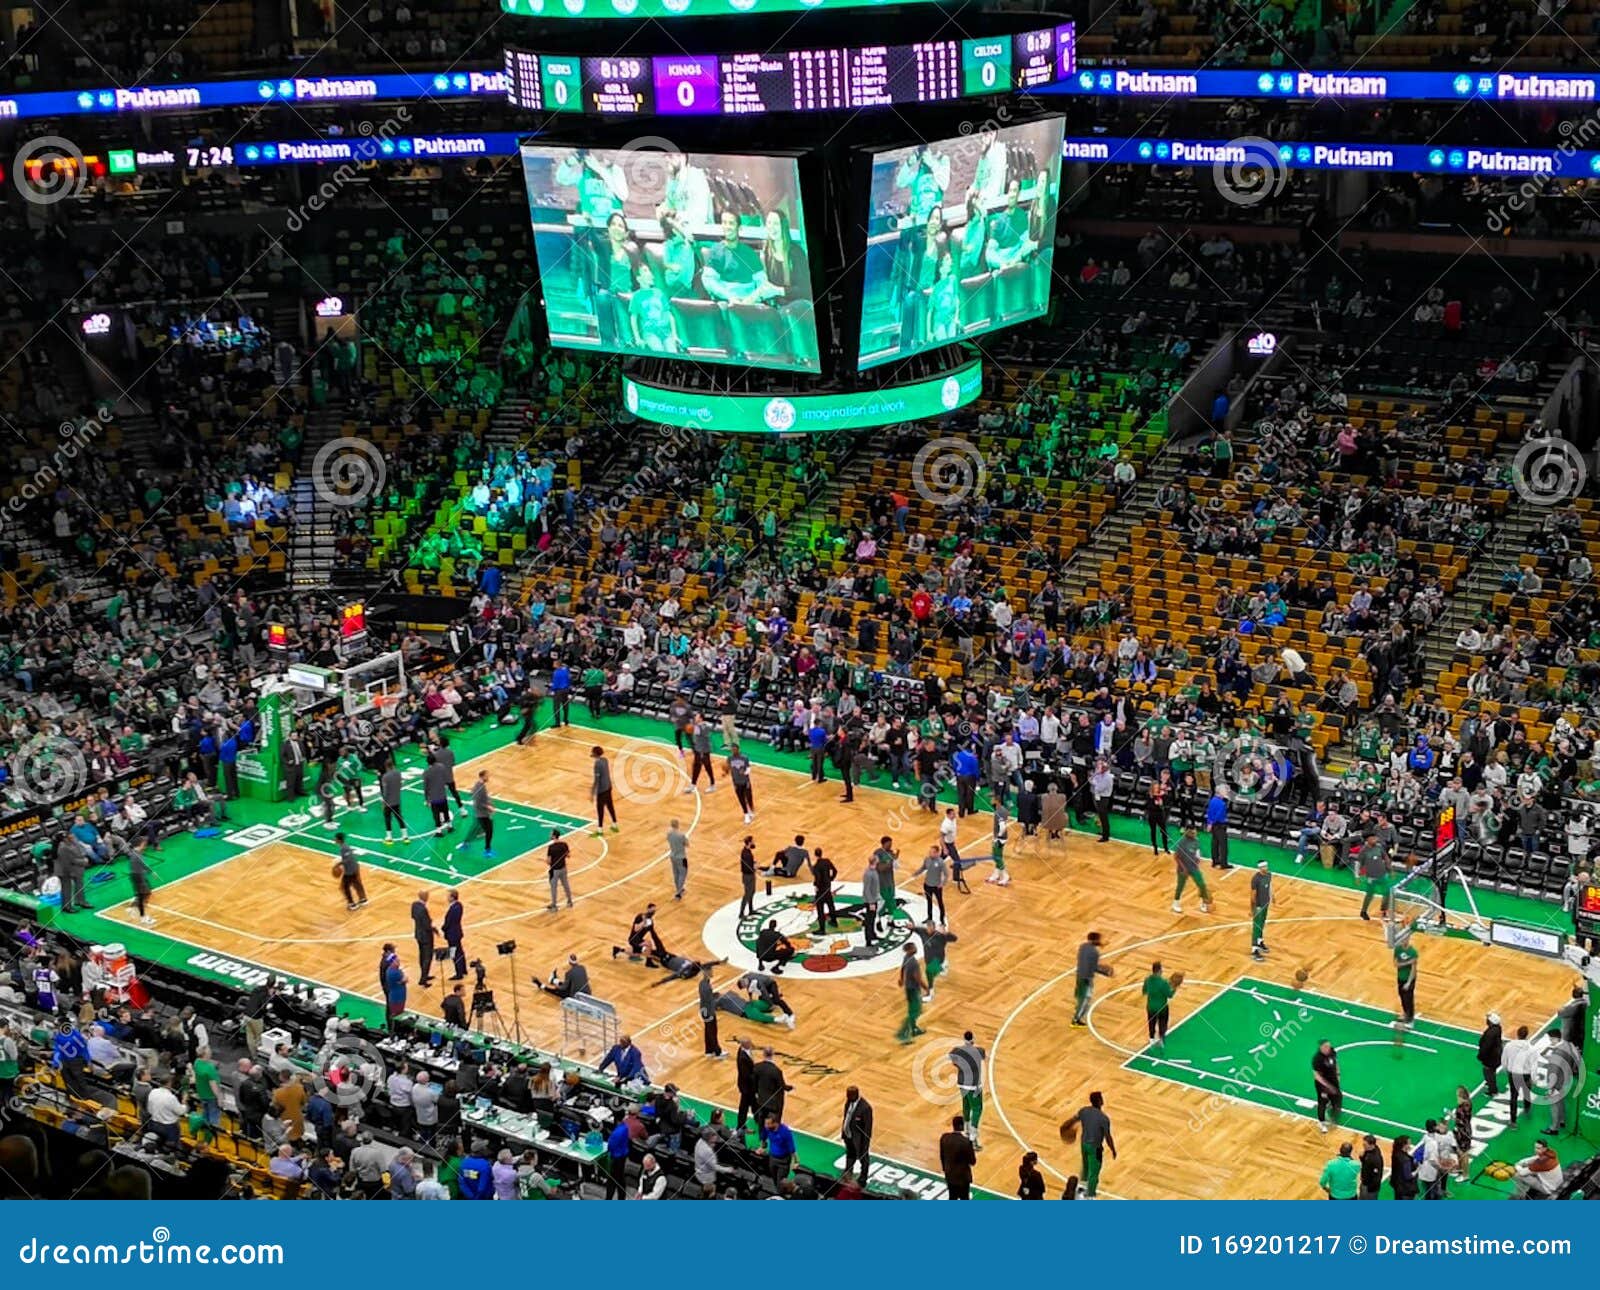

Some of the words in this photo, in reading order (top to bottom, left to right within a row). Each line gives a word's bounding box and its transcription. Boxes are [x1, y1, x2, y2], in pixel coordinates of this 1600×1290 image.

[668, 64, 702, 76] KINGS
[982, 61, 996, 87] 0
[296, 78, 377, 98] Putnam
[554, 79, 568, 105] 0
[1116, 71, 1197, 93] Putnam
[1298, 73, 1387, 95] Putnam
[1498, 74, 1595, 98] Putnam
[116, 87, 201, 108] Putnam
[677, 81, 695, 107] 0
[137, 150, 175, 165] Bank
[186, 146, 233, 167] 7:24
[278, 143, 351, 161] Putnam
[413, 137, 486, 155] Putnam
[1171, 142, 1245, 163] Putnam
[1314, 145, 1393, 166] Putnam
[1468, 150, 1552, 172] Putnam
[802, 404, 866, 421] imagination
[880, 400, 905, 412] work
[0, 815, 41, 835] ARDEN
